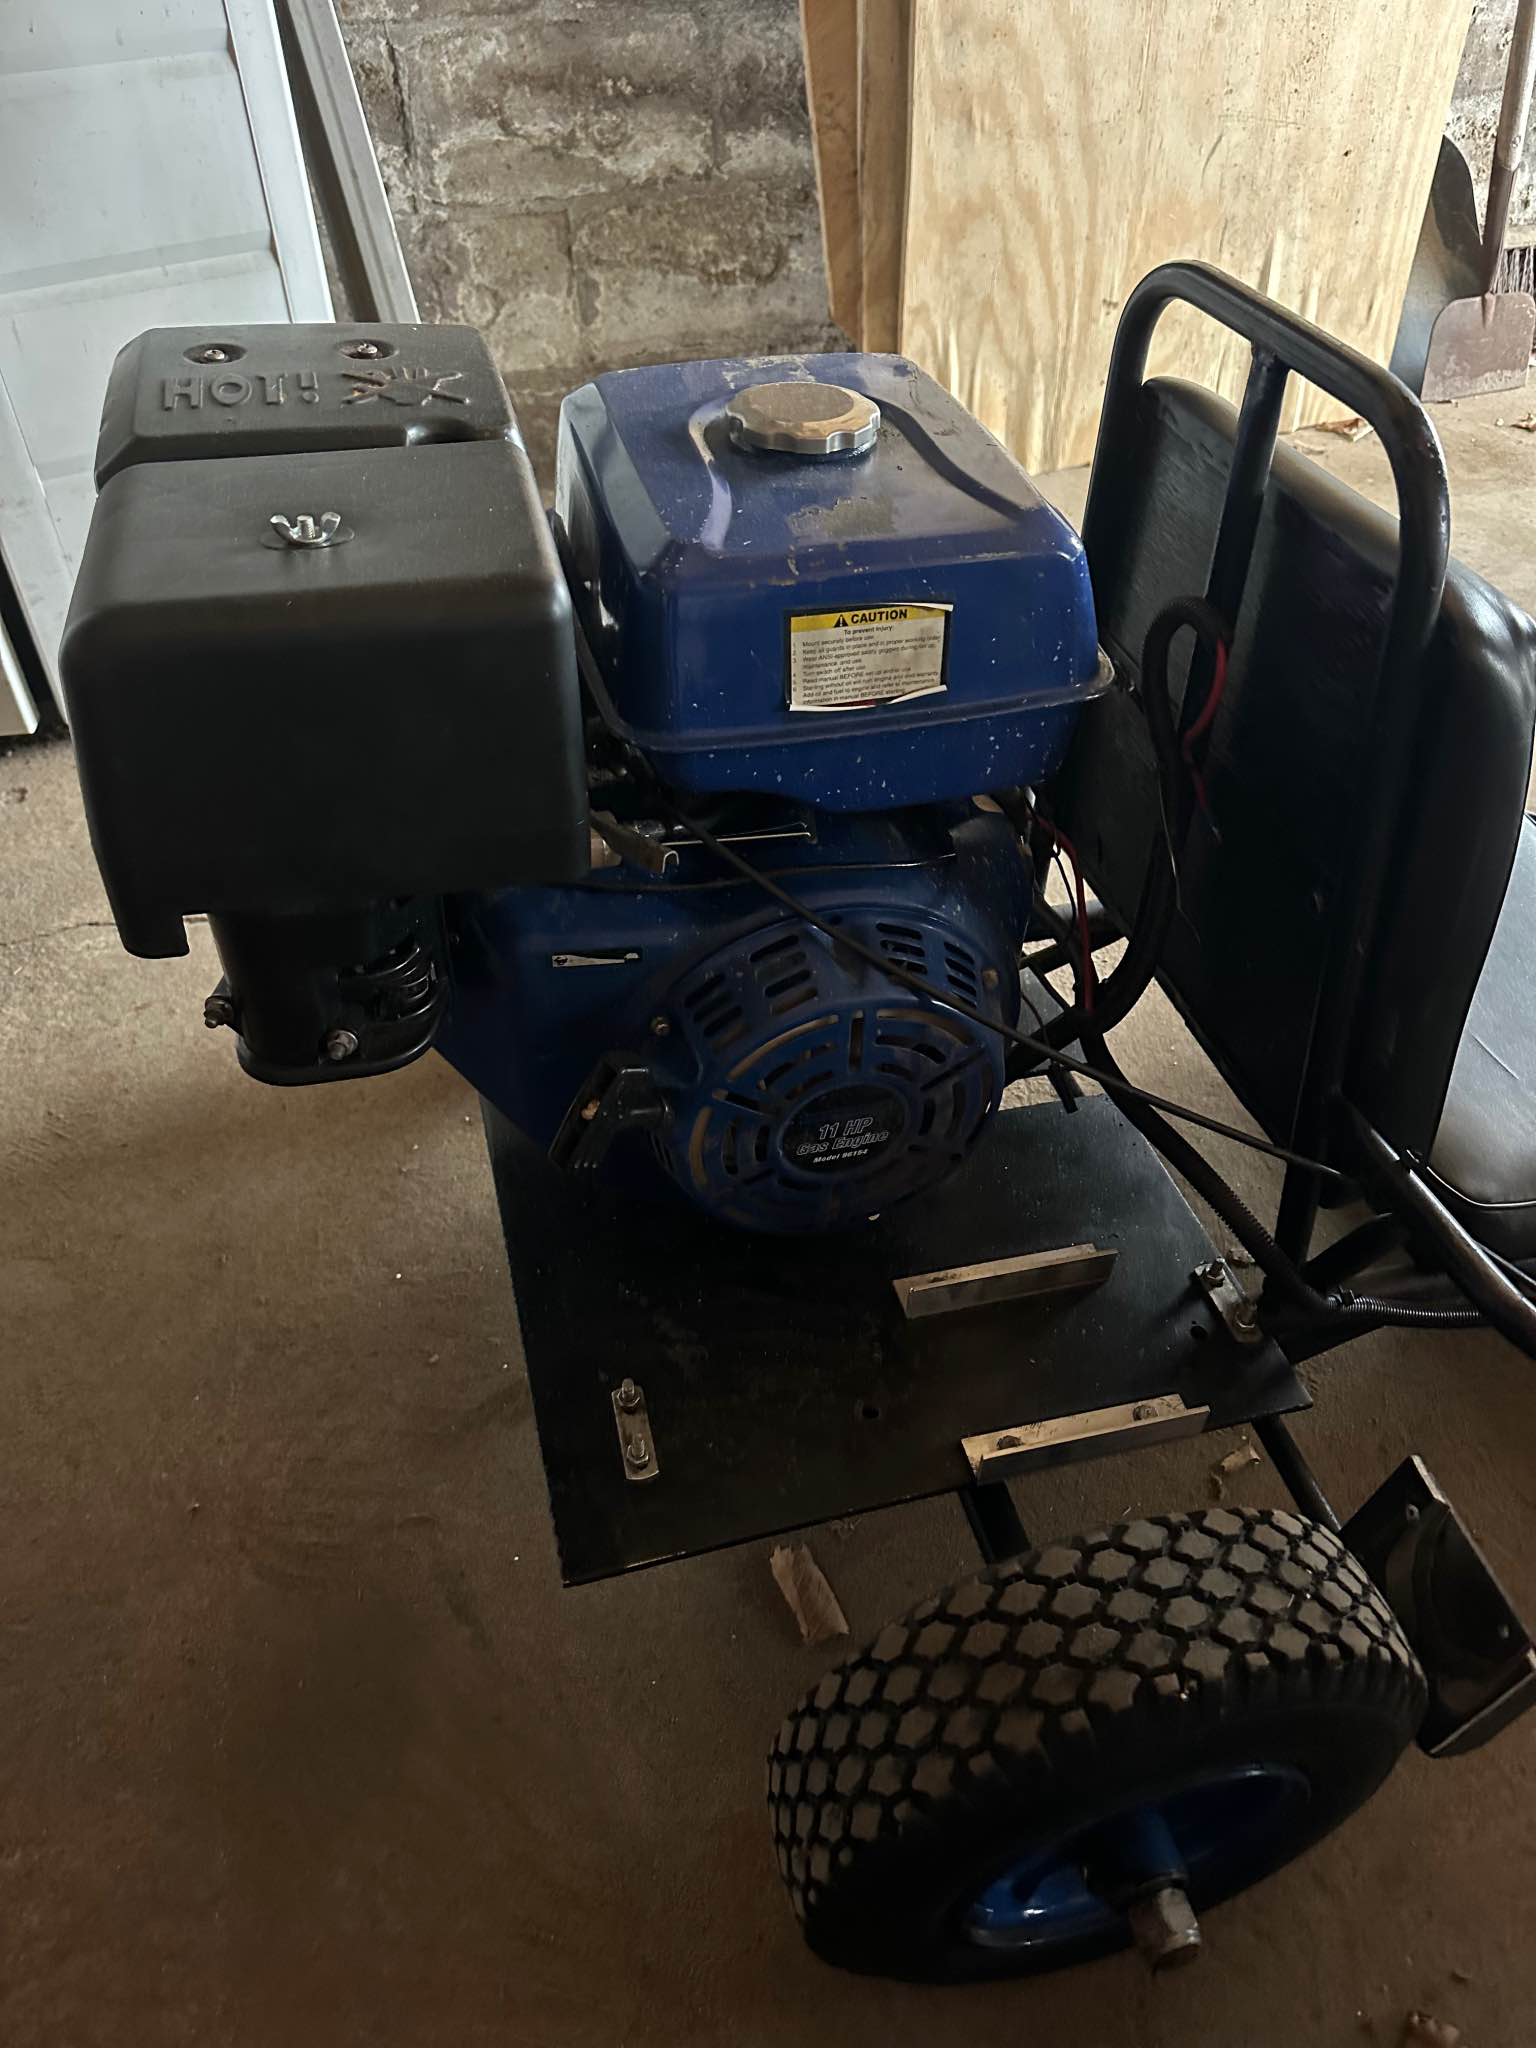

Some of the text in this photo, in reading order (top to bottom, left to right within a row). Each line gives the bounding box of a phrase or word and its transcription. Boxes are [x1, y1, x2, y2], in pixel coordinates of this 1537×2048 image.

[161, 371, 319, 411] HOT!
[851, 609, 908, 624] CAUTION
[852, 627, 874, 635] prevent
[820, 1117, 874, 1140] 11 HP
[796, 1130, 889, 1156] Gas Engine
[813, 1153, 840, 1163] Model
